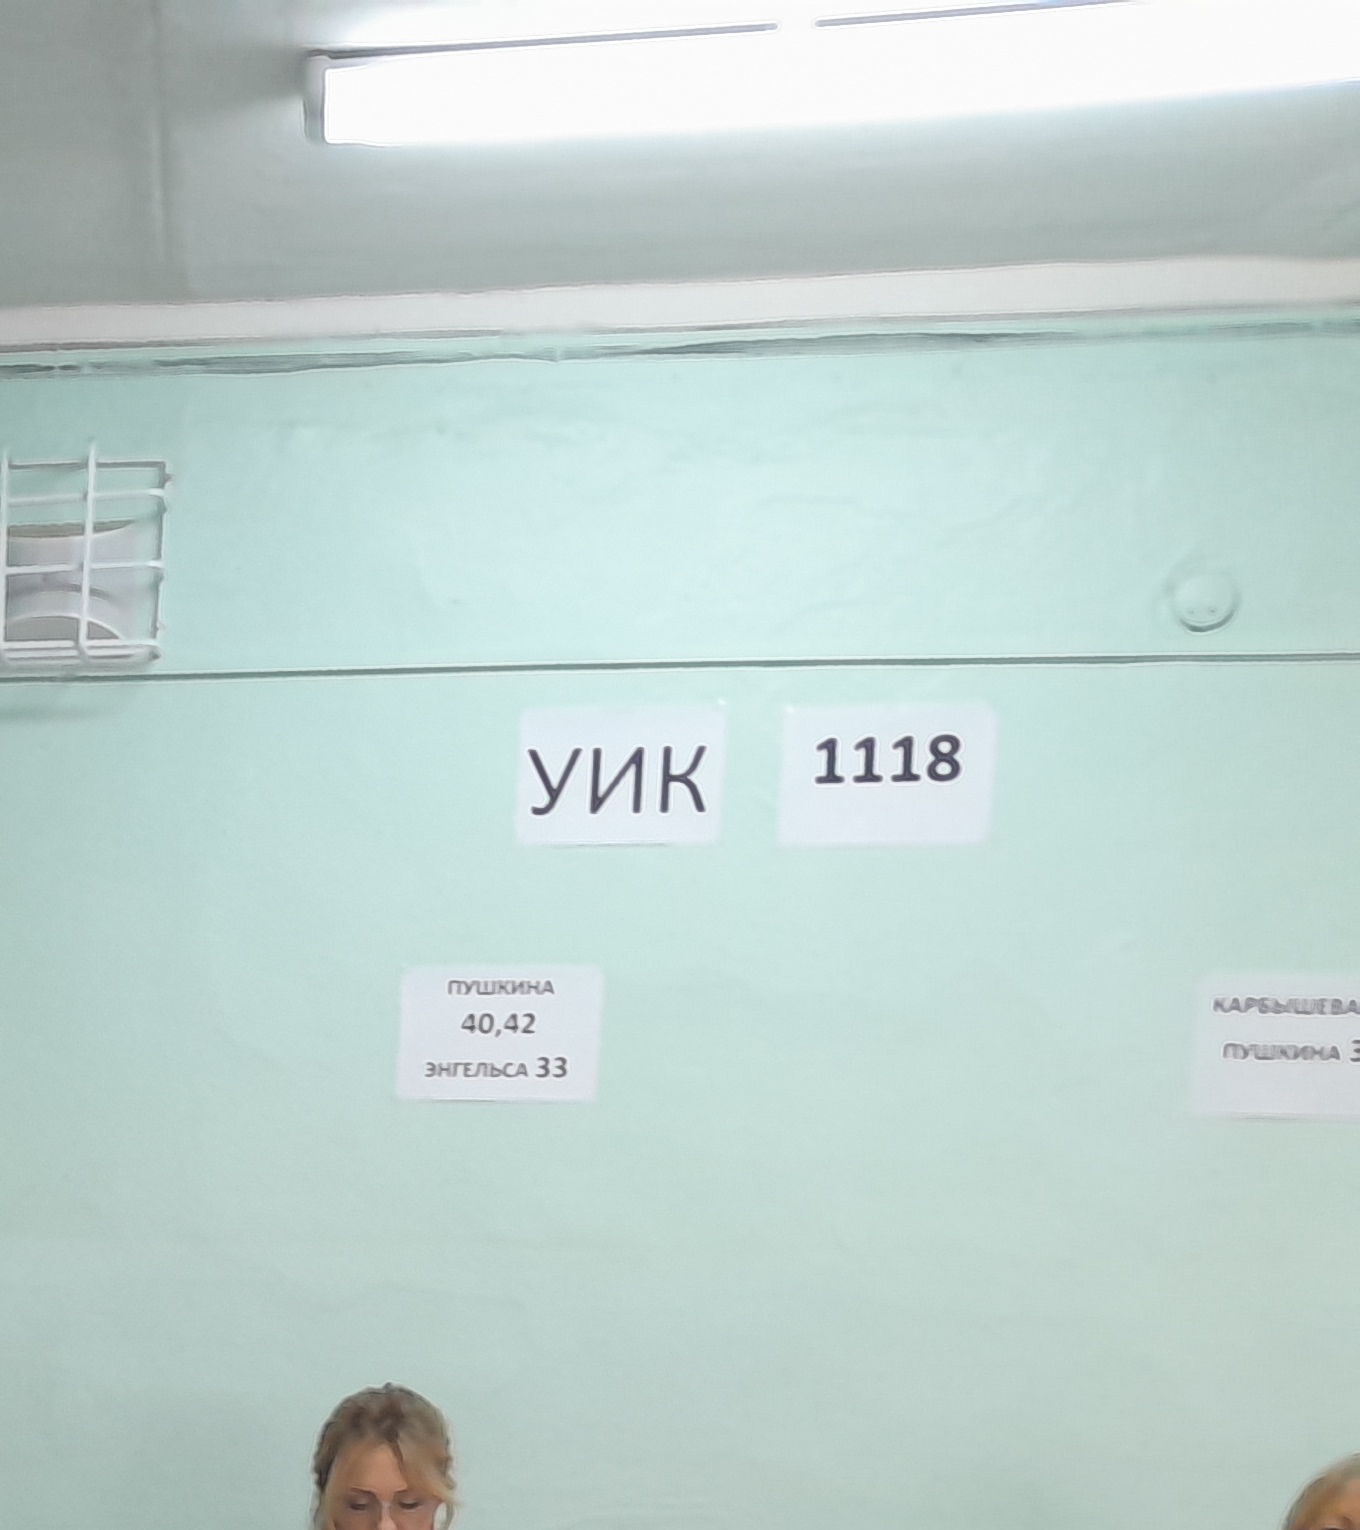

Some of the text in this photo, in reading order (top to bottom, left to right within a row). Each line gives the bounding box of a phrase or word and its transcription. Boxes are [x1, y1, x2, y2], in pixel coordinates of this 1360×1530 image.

[527, 734, 962, 816] УИК 1118
[447, 979, 555, 995] ПУШКИНА
[461, 1013, 536, 1037] 40,42
[1222, 1042, 1341, 1061] ПУШКИНА
[424, 1056, 568, 1078] ЭНГЕЛЬСА 33
